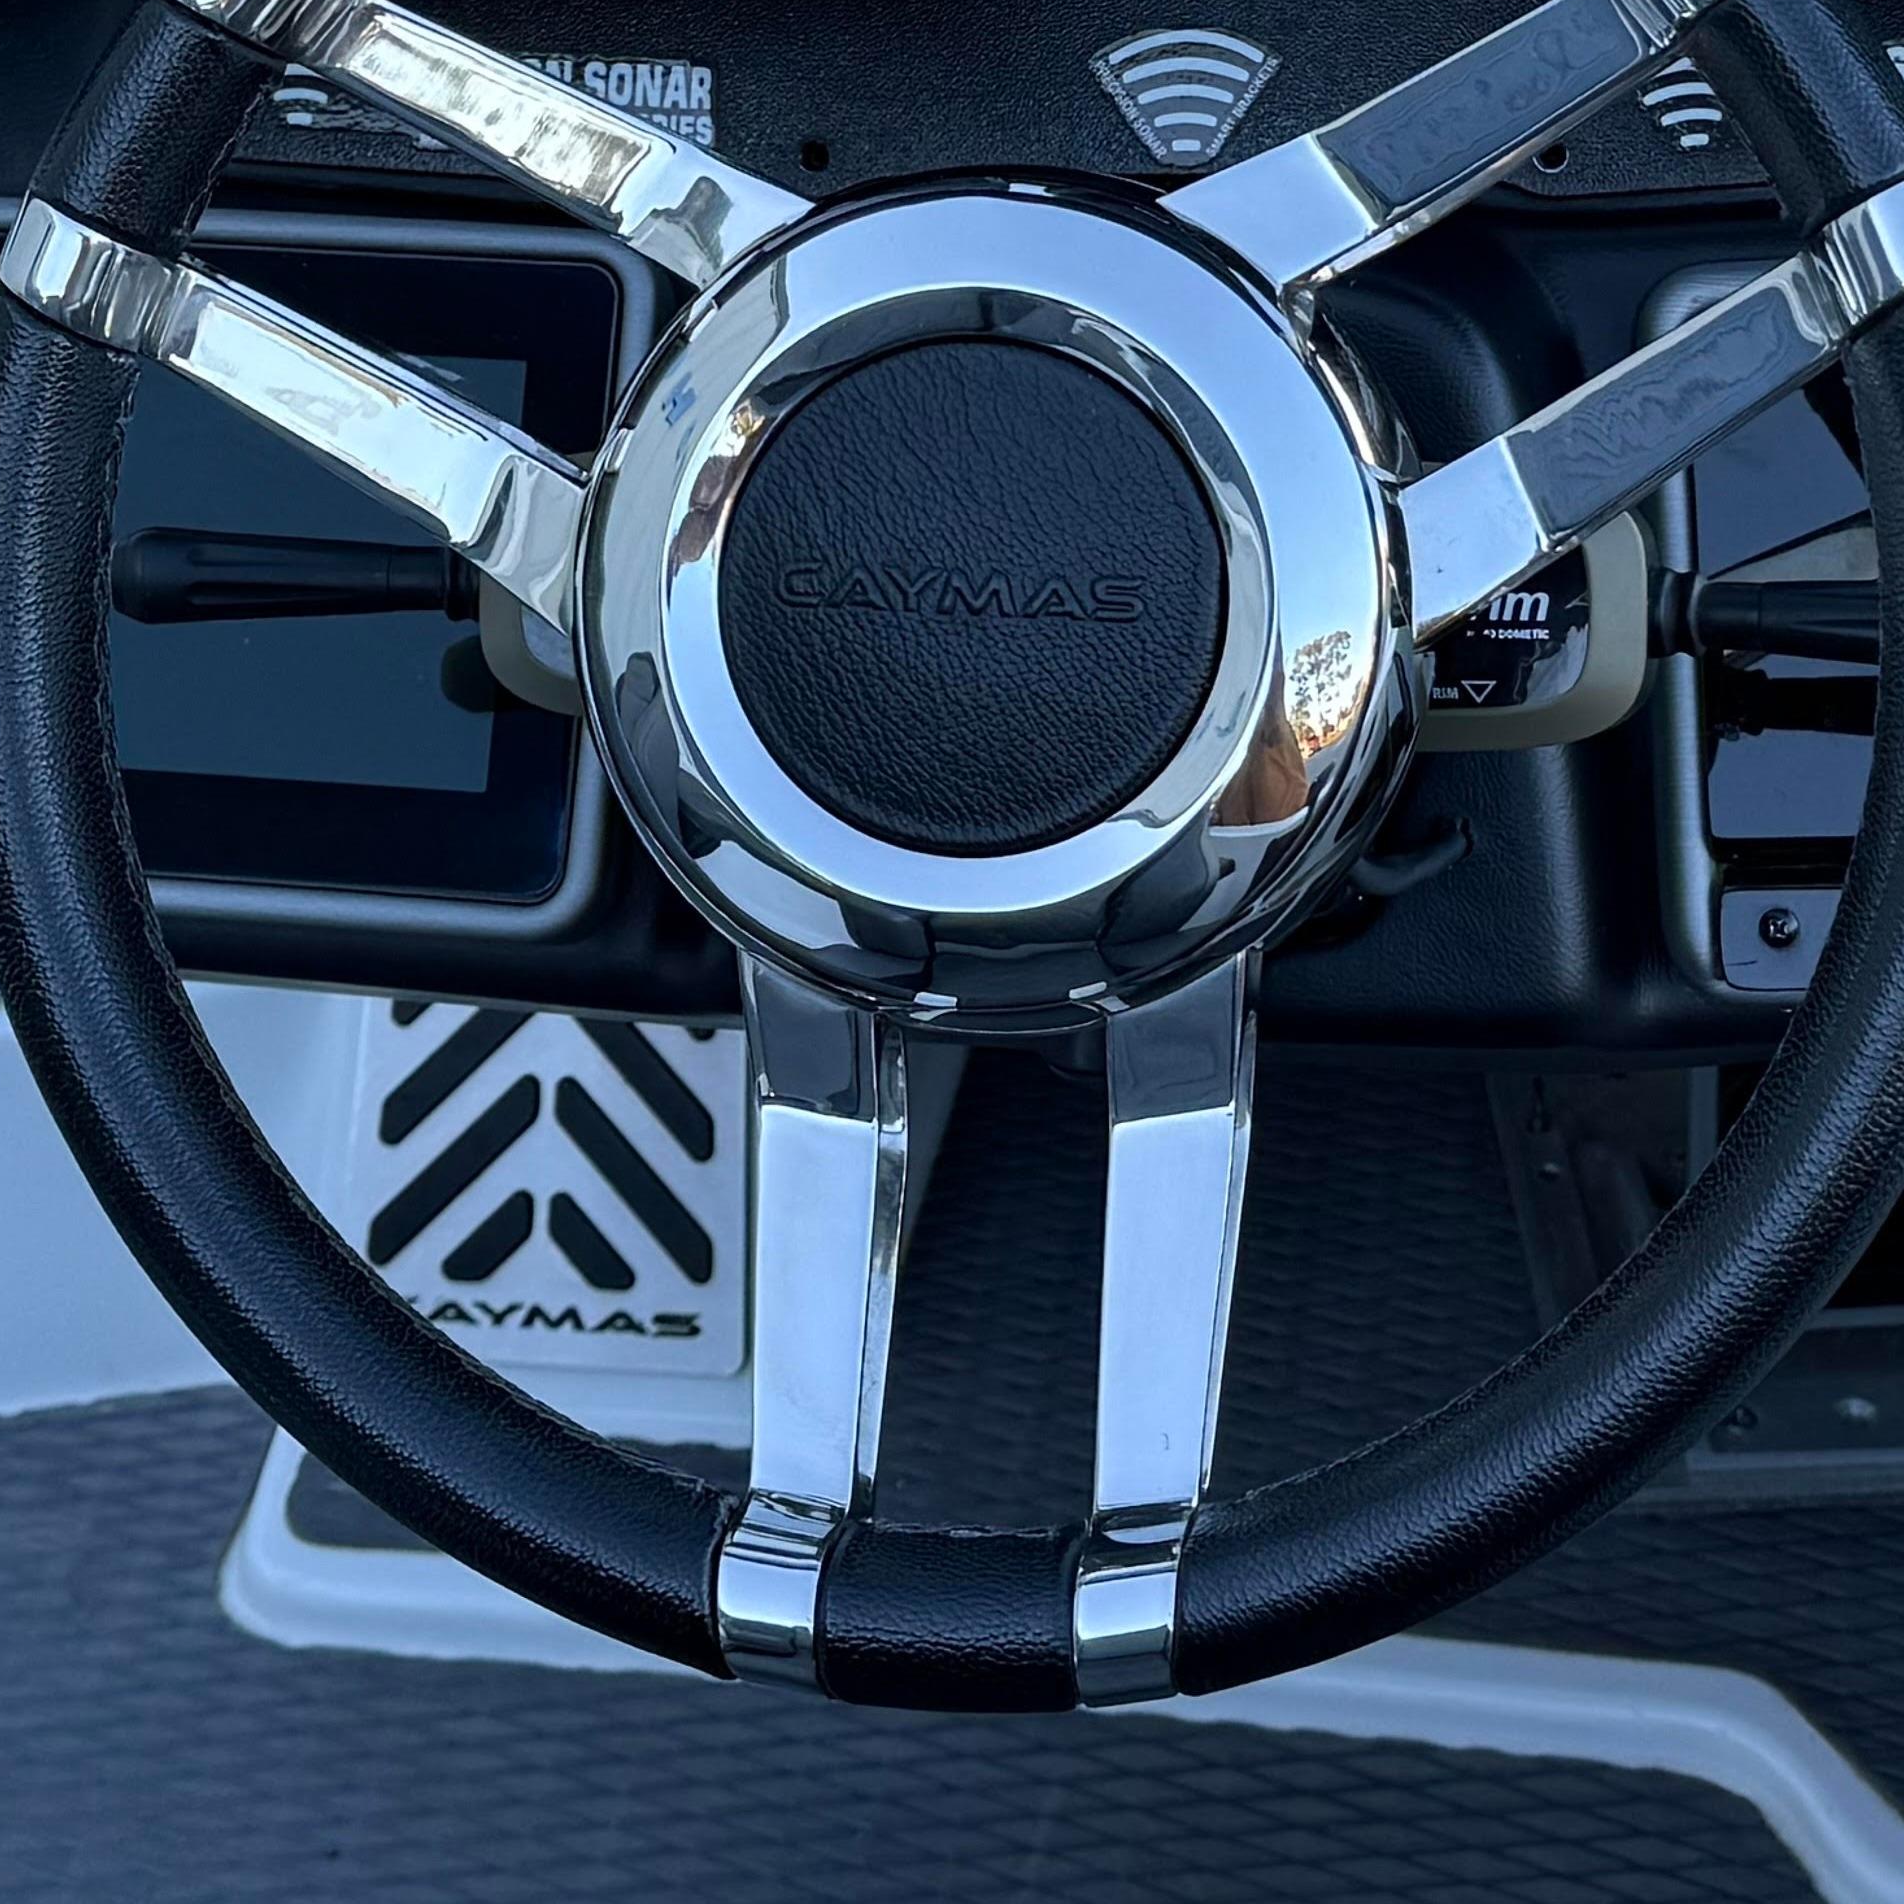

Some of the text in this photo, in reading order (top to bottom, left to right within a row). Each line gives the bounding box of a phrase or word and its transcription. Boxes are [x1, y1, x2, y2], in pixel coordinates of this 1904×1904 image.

[584, 60, 713, 110] SONAR
[1205, 55, 1280, 158] SMART BRACKETS
[1133, 115, 1168, 160] SONAR
[778, 561, 1146, 624] CAYMAS
[407, 1295, 702, 1338] AYMAS
